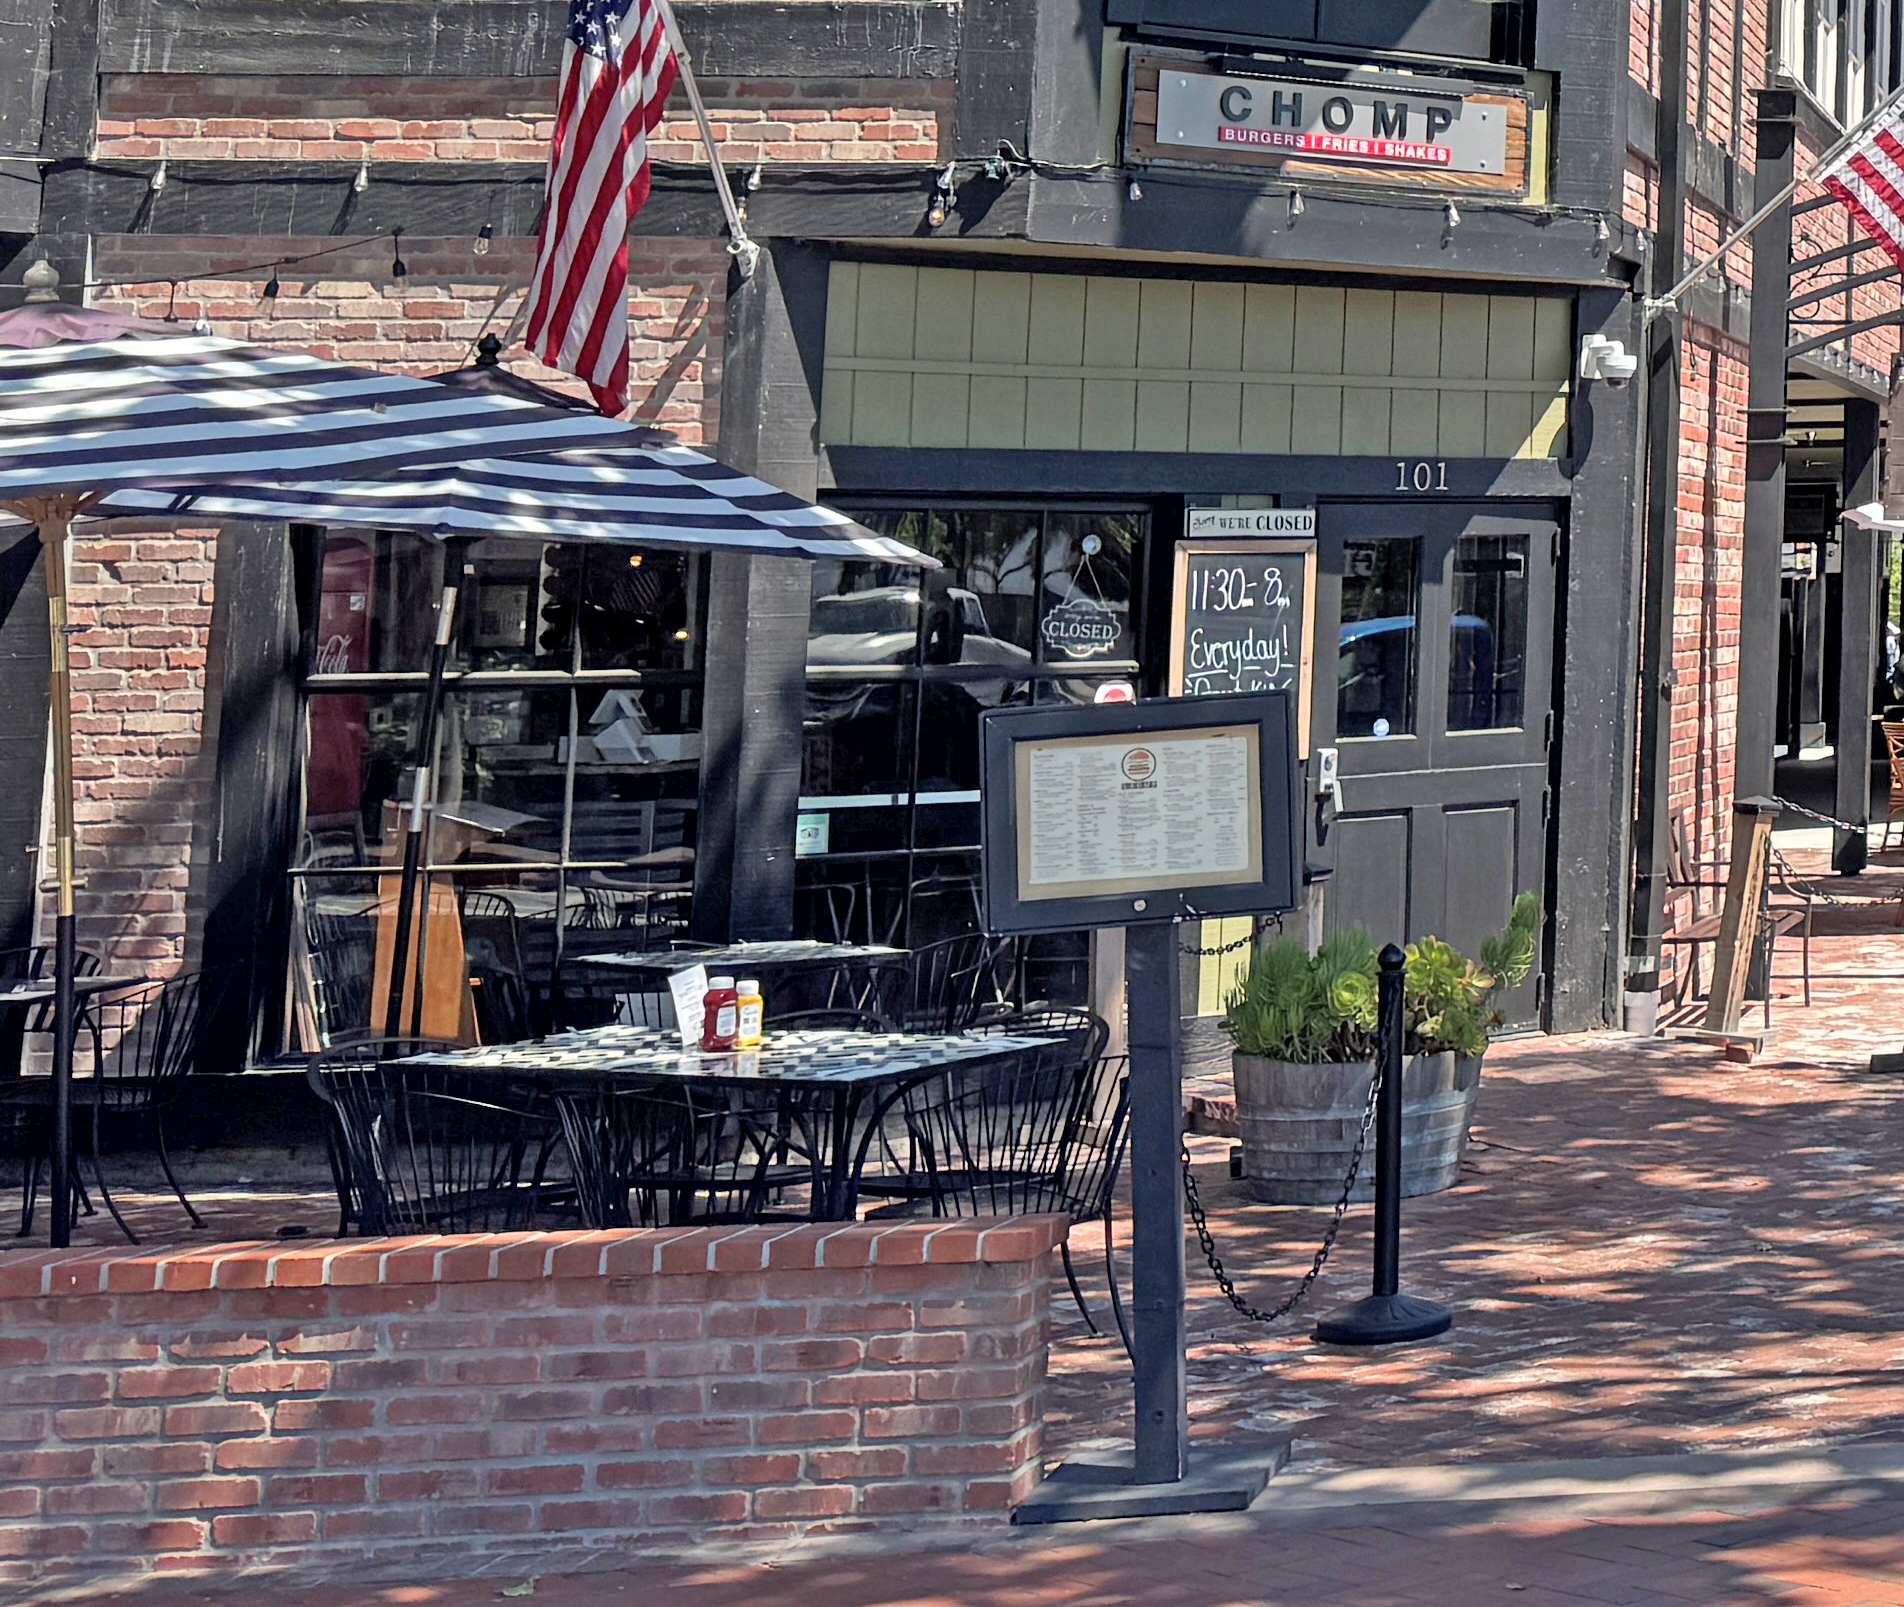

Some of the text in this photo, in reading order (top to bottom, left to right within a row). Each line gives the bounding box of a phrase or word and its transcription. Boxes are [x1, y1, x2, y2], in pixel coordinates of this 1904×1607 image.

[1220, 85, 1454, 144] CHOMP
[1225, 128, 1448, 162] BURGERS FRIES SHAKES
[1395, 461, 1449, 492] 101
[1256, 515, 1312, 531] CLOSED
[1049, 621, 1112, 639] CLOSED
[1190, 624, 1289, 678] Everyday!
